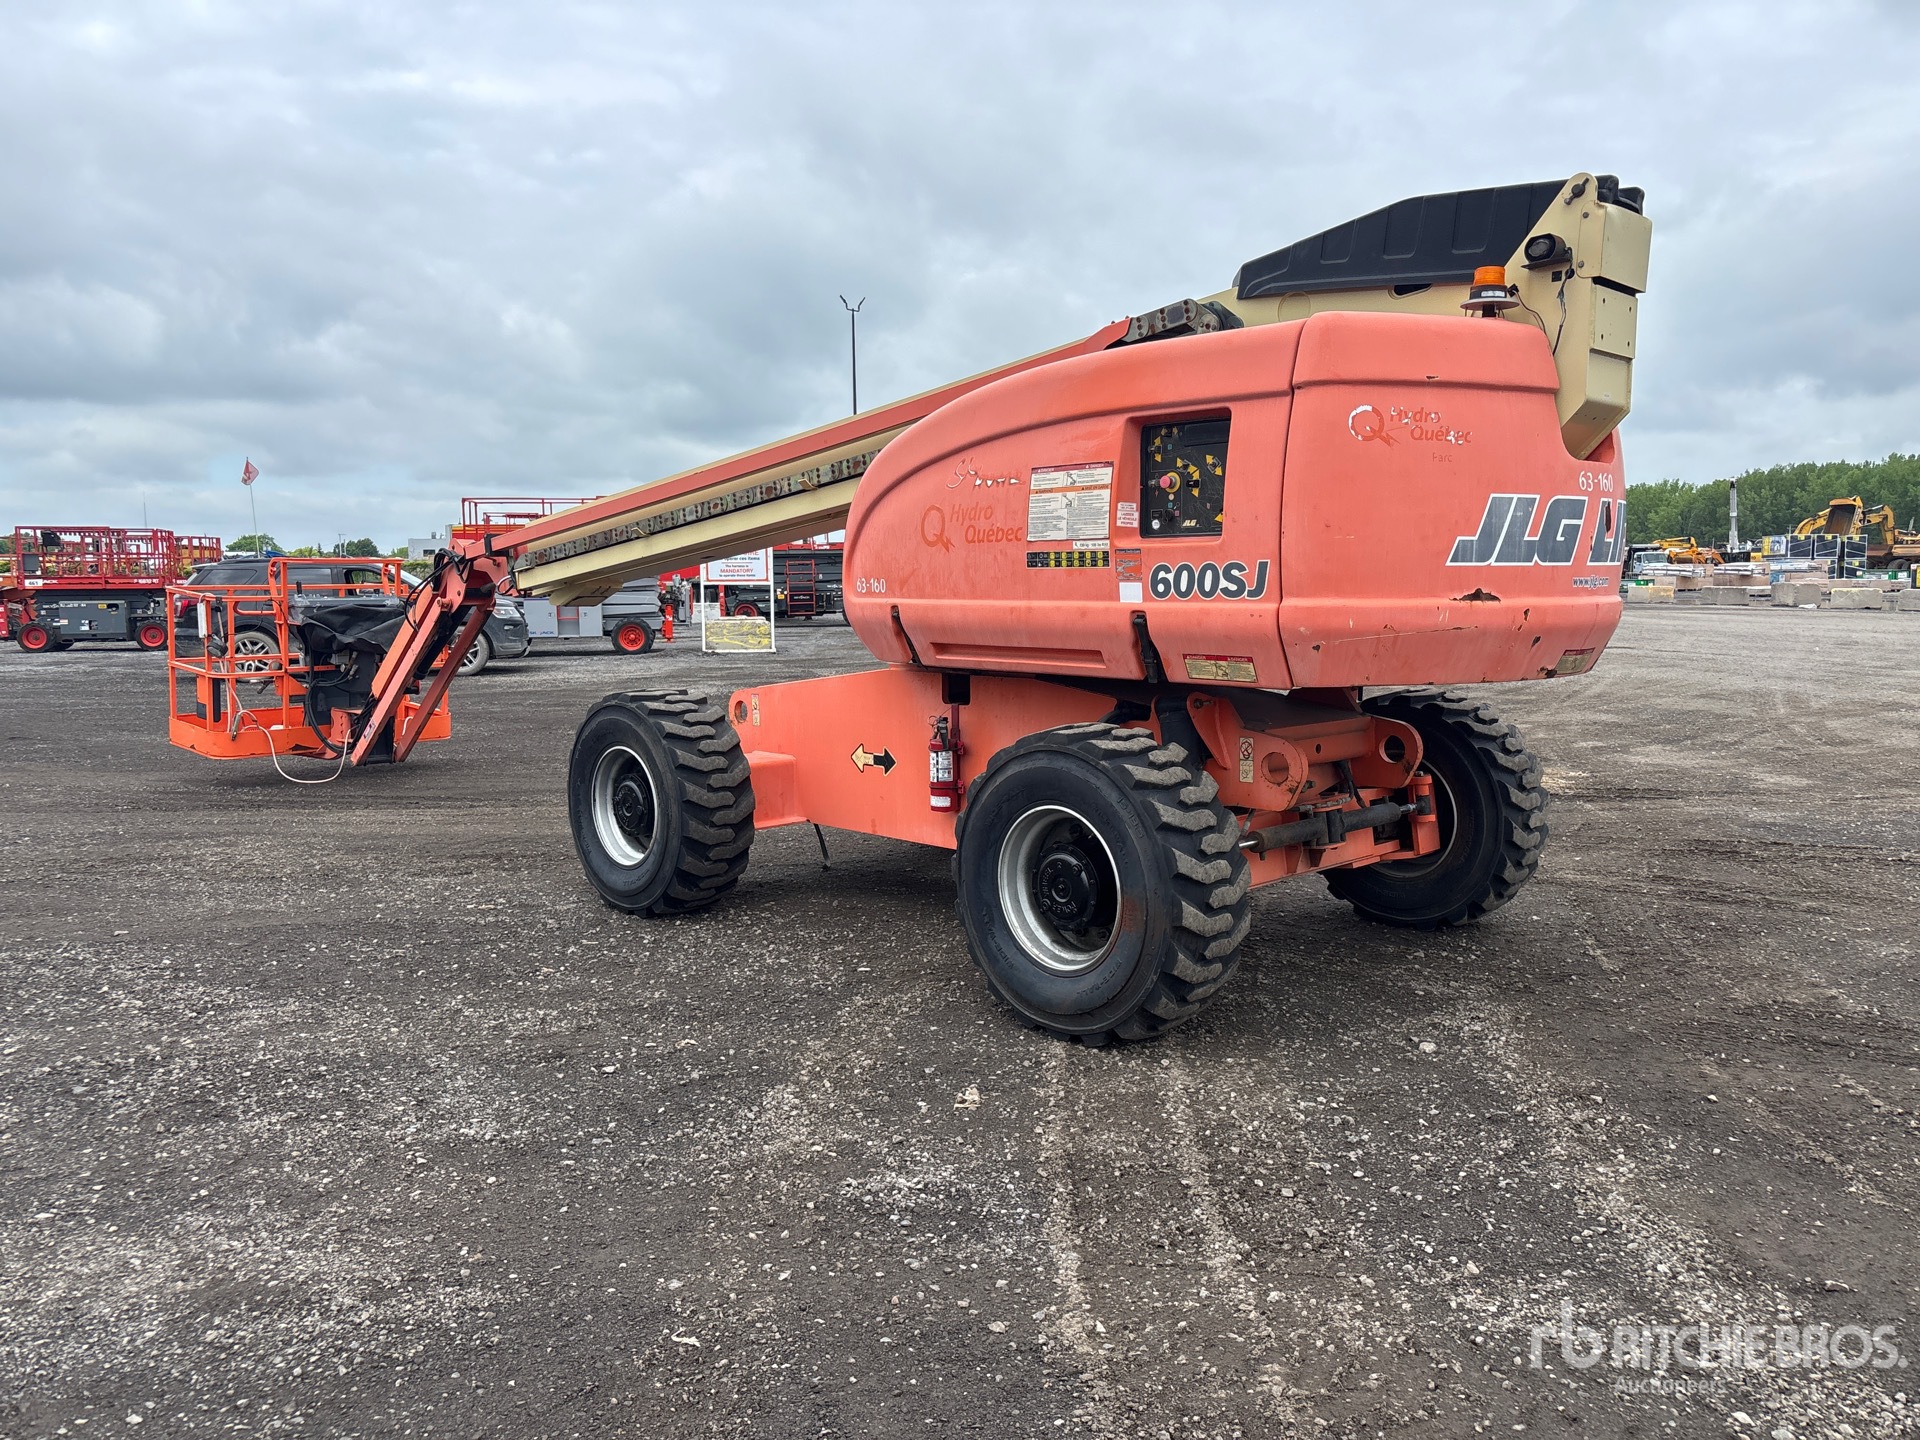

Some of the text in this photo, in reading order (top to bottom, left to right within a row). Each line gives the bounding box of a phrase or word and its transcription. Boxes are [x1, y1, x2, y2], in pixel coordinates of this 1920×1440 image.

[1389, 406, 1441, 426] Hydro
[1409, 425, 1473, 445] Québec
[1579, 470, 1613, 493] 63-160
[950, 502, 993, 526] Hydro
[1182, 519, 1197, 527] JLG
[965, 523, 1023, 544] Québec
[1445, 494, 1588, 566] JLG
[856, 577, 886, 593] 63-160
[1149, 560, 1270, 600] 600SJ
[1572, 574, 1609, 590] www.jlg.com
